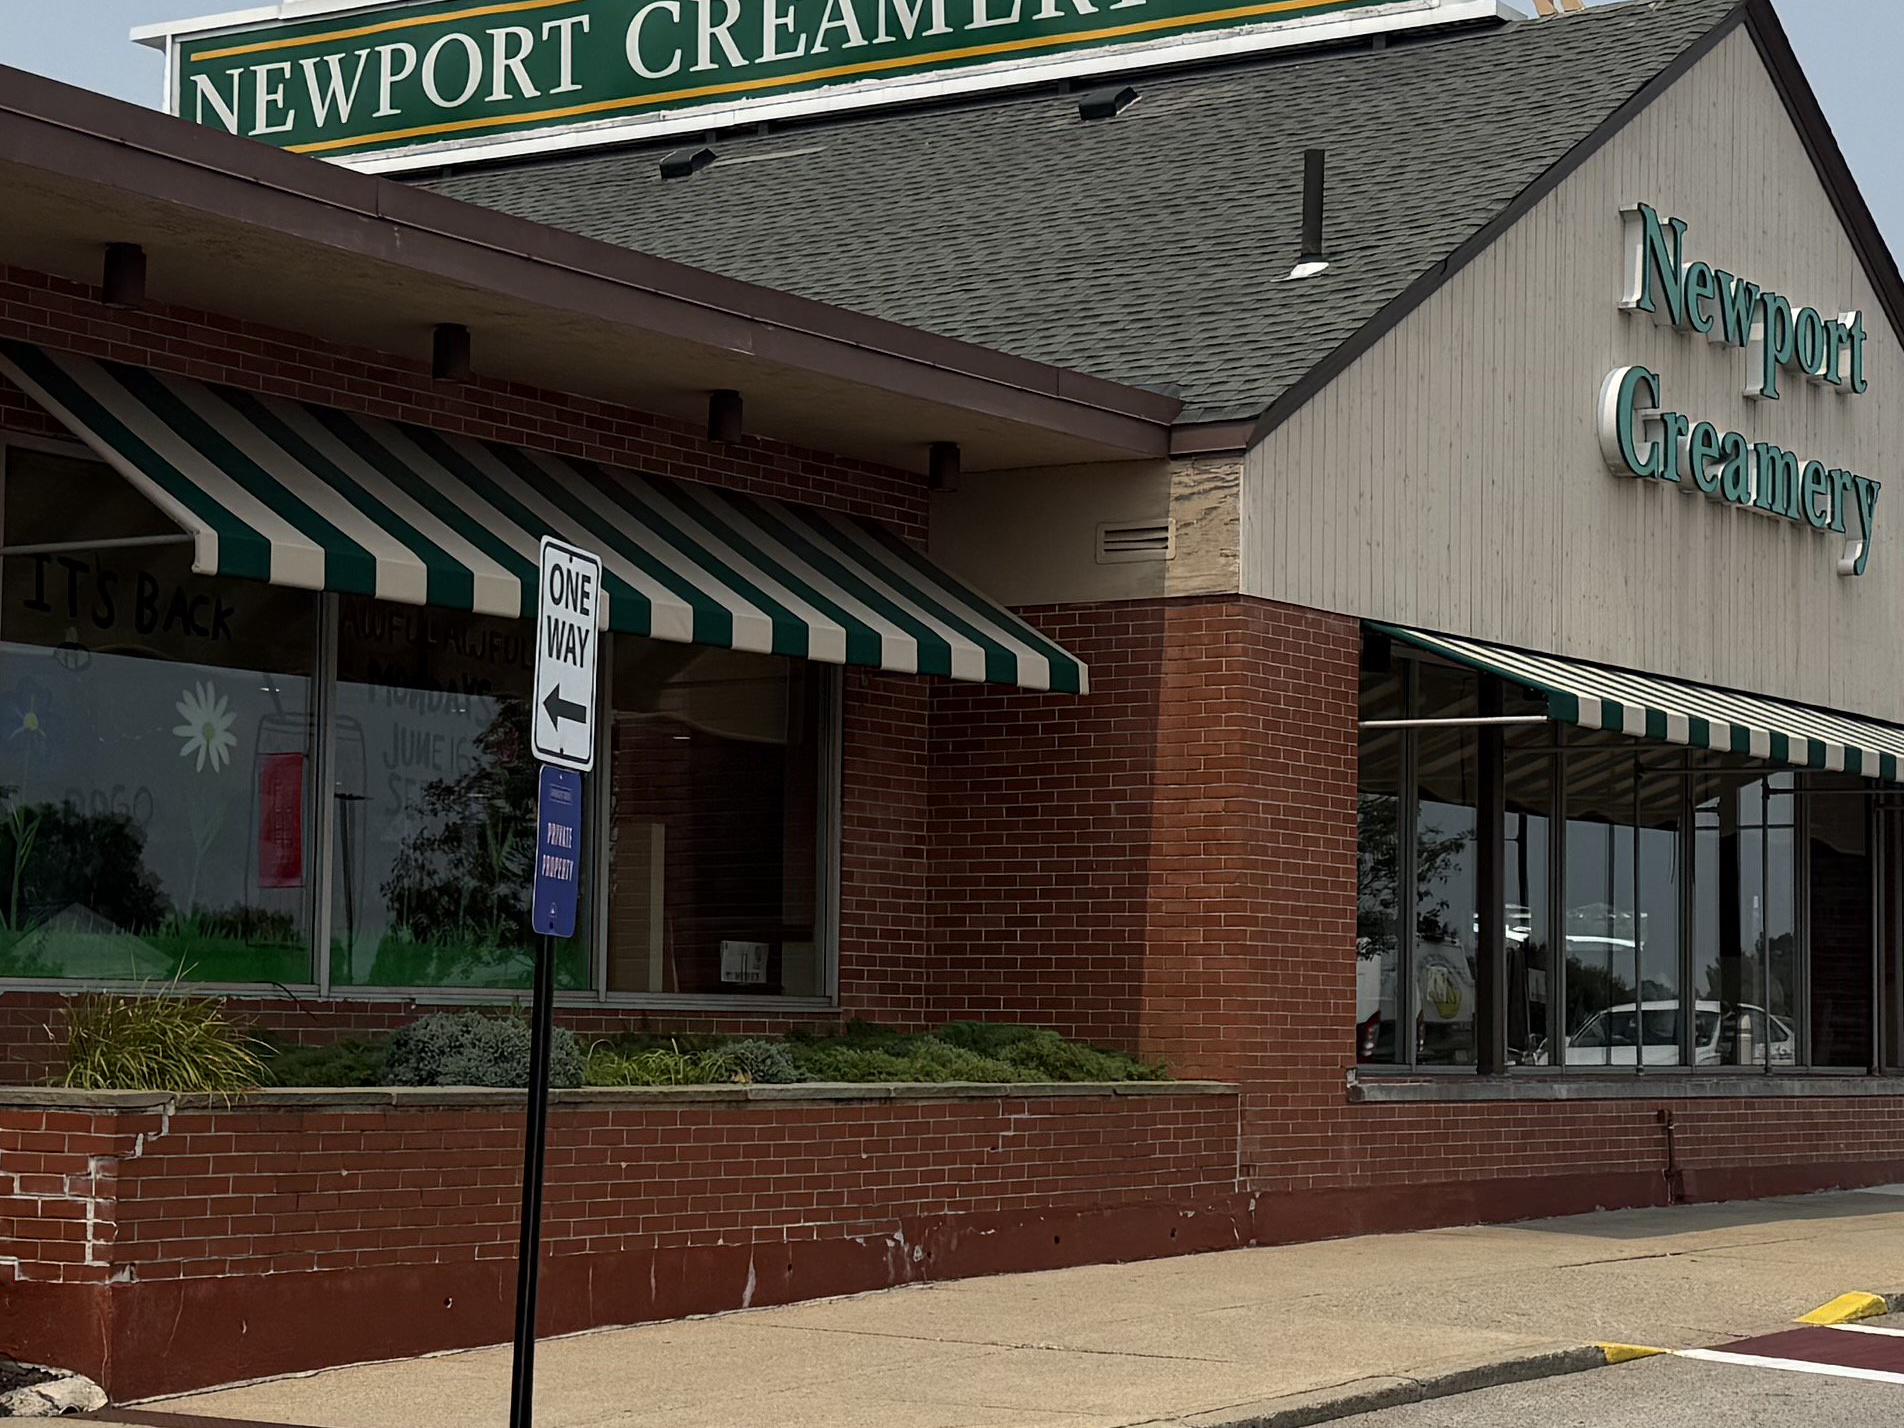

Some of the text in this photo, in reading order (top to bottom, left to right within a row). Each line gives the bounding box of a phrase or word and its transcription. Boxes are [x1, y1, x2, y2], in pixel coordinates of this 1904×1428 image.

[189, 14, 591, 137] NEWPORT
[1620, 202, 1868, 400] Newport
[1601, 365, 1882, 576] Creamery
[23, 551, 119, 630] IT'S
[549, 563, 591, 617] ONE
[546, 614, 590, 669] WAY
[541, 854, 574, 882] PROPERTY
[547, 822, 573, 849] PRIVATE
